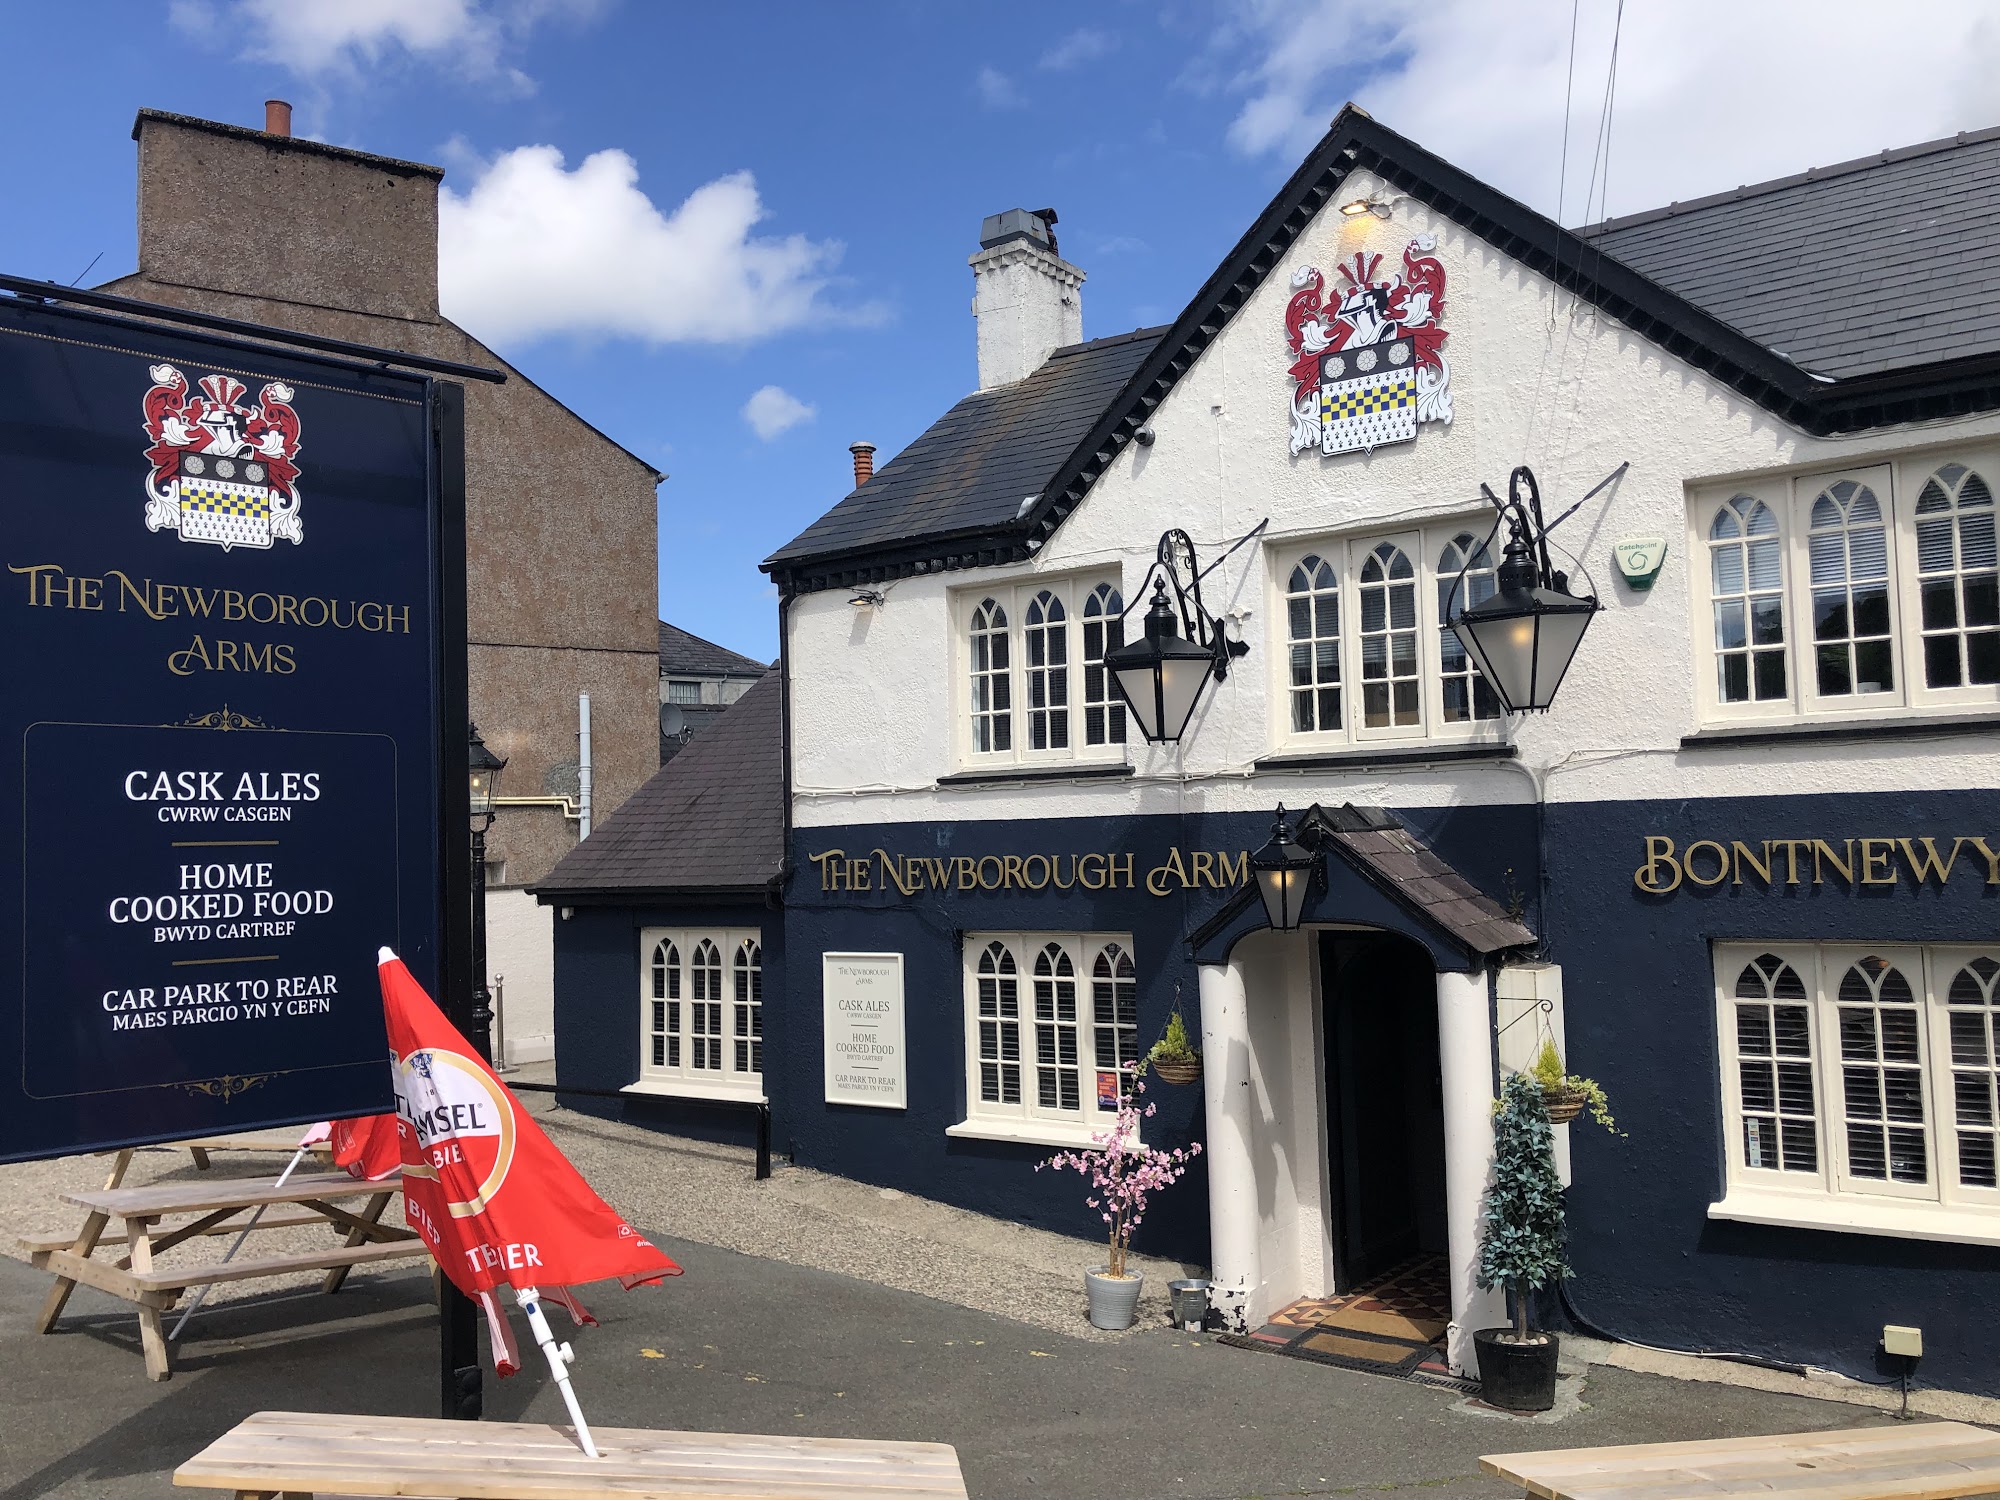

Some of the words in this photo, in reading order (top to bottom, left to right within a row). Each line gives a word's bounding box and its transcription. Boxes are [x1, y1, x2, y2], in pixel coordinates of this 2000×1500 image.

[1618, 541, 1658, 551] Catchpoint
[7, 564, 104, 610] THE
[104, 570, 412, 634] NEWBOROUGH
[167, 635, 298, 676] ARMS
[124, 770, 225, 801] CASK
[231, 771, 321, 802] ALES
[157, 806, 220, 823] CWRW
[223, 806, 292, 822] CASGEN
[179, 863, 273, 890] HOME
[808, 848, 872, 892] THE
[870, 848, 1136, 897] NEWBOROUGH
[1146, 846, 1249, 897] ARM
[108, 893, 244, 924] COOKED
[253, 890, 334, 917] FOOD
[153, 925, 211, 943] BWYD
[215, 921, 296, 940] CARTREF
[102, 989, 157, 1012] CAR
[163, 981, 231, 1007] PARK
[236, 979, 269, 1001] TO
[276, 974, 339, 998] REAR
[838, 999, 863, 1011] CASK
[865, 1000, 890, 1012] ALES
[112, 1012, 167, 1031] MAES
[172, 1004, 239, 1026] PARCIO
[242, 1003, 267, 1020] YN
[271, 1001, 283, 1017] Y
[286, 998, 331, 1016] CEFN
[836, 1042, 870, 1054] COOKED
[871, 1044, 895, 1055] FOOD
[852, 1033, 877, 1043] HOME
[835, 1073, 849, 1082] CAR
[849, 1074, 867, 1084] PARK
[868, 1076, 877, 1085] TO
[878, 1077, 896, 1086] REAR
[432, 1143, 466, 1169] BIE
